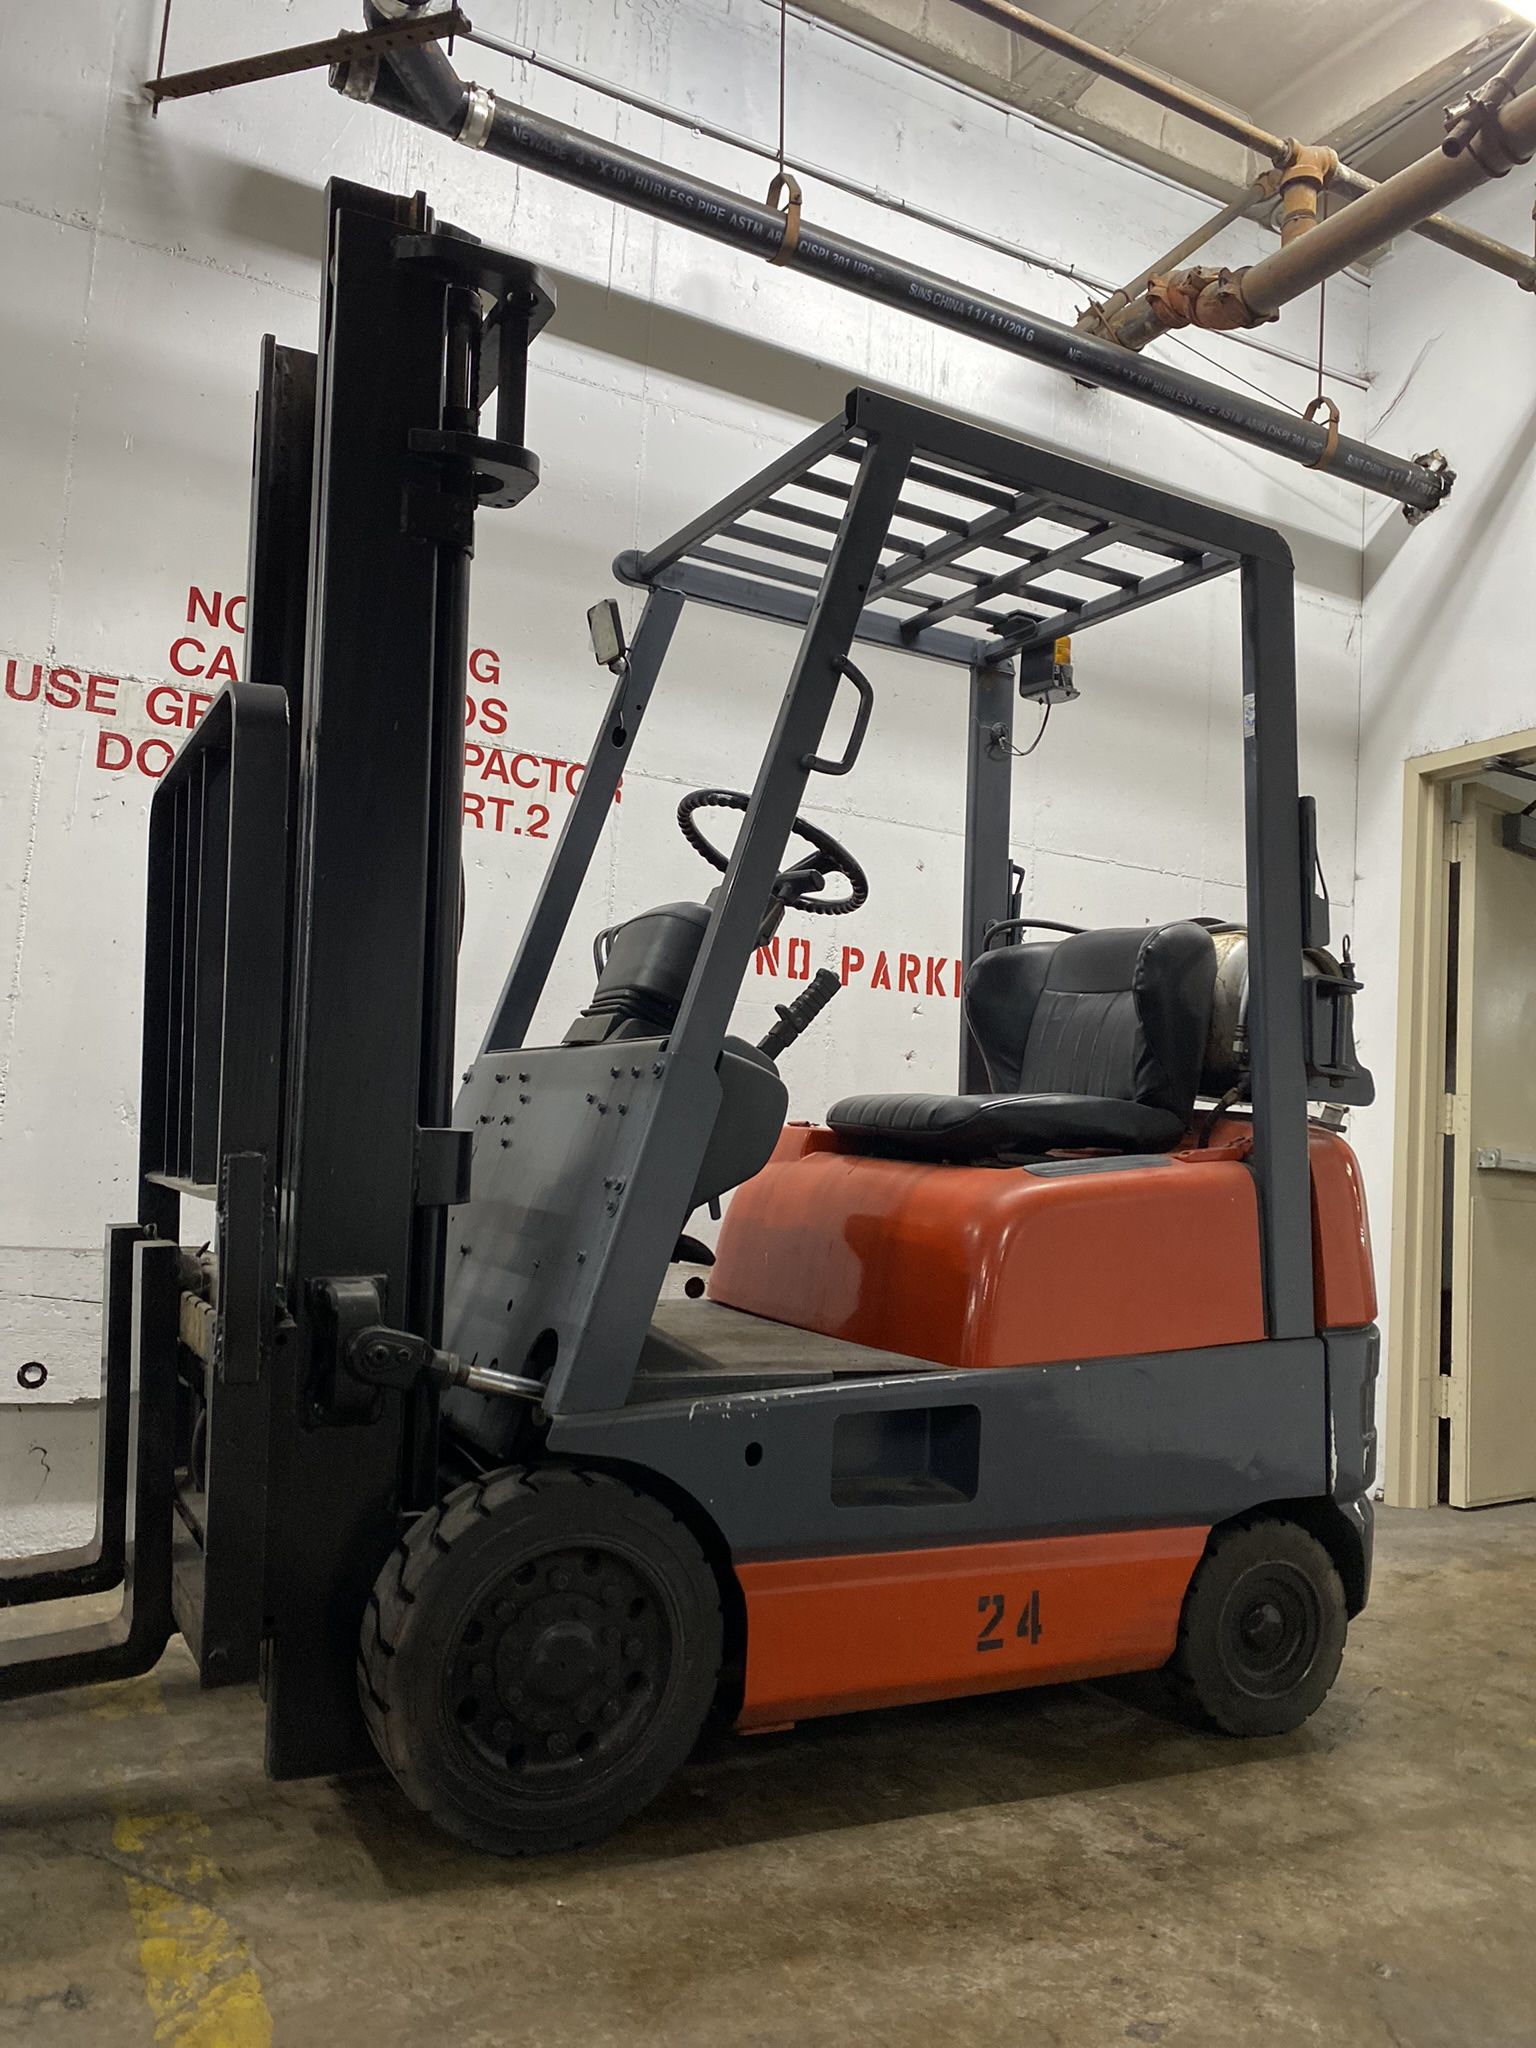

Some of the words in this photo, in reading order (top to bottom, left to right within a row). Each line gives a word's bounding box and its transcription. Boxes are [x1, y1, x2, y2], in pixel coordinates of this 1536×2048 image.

[634, 175, 694, 208] HUBLESS
[696, 199, 726, 221] PIPE
[729, 213, 764, 235] ASTM
[799, 240, 830, 262] CISPI
[933, 291, 965, 316] CHINA
[1152, 380, 1193, 406] HUBLESS
[5, 659, 119, 716] USE
[756, 936, 810, 981] NO
[976, 1590, 1042, 1652] 24
